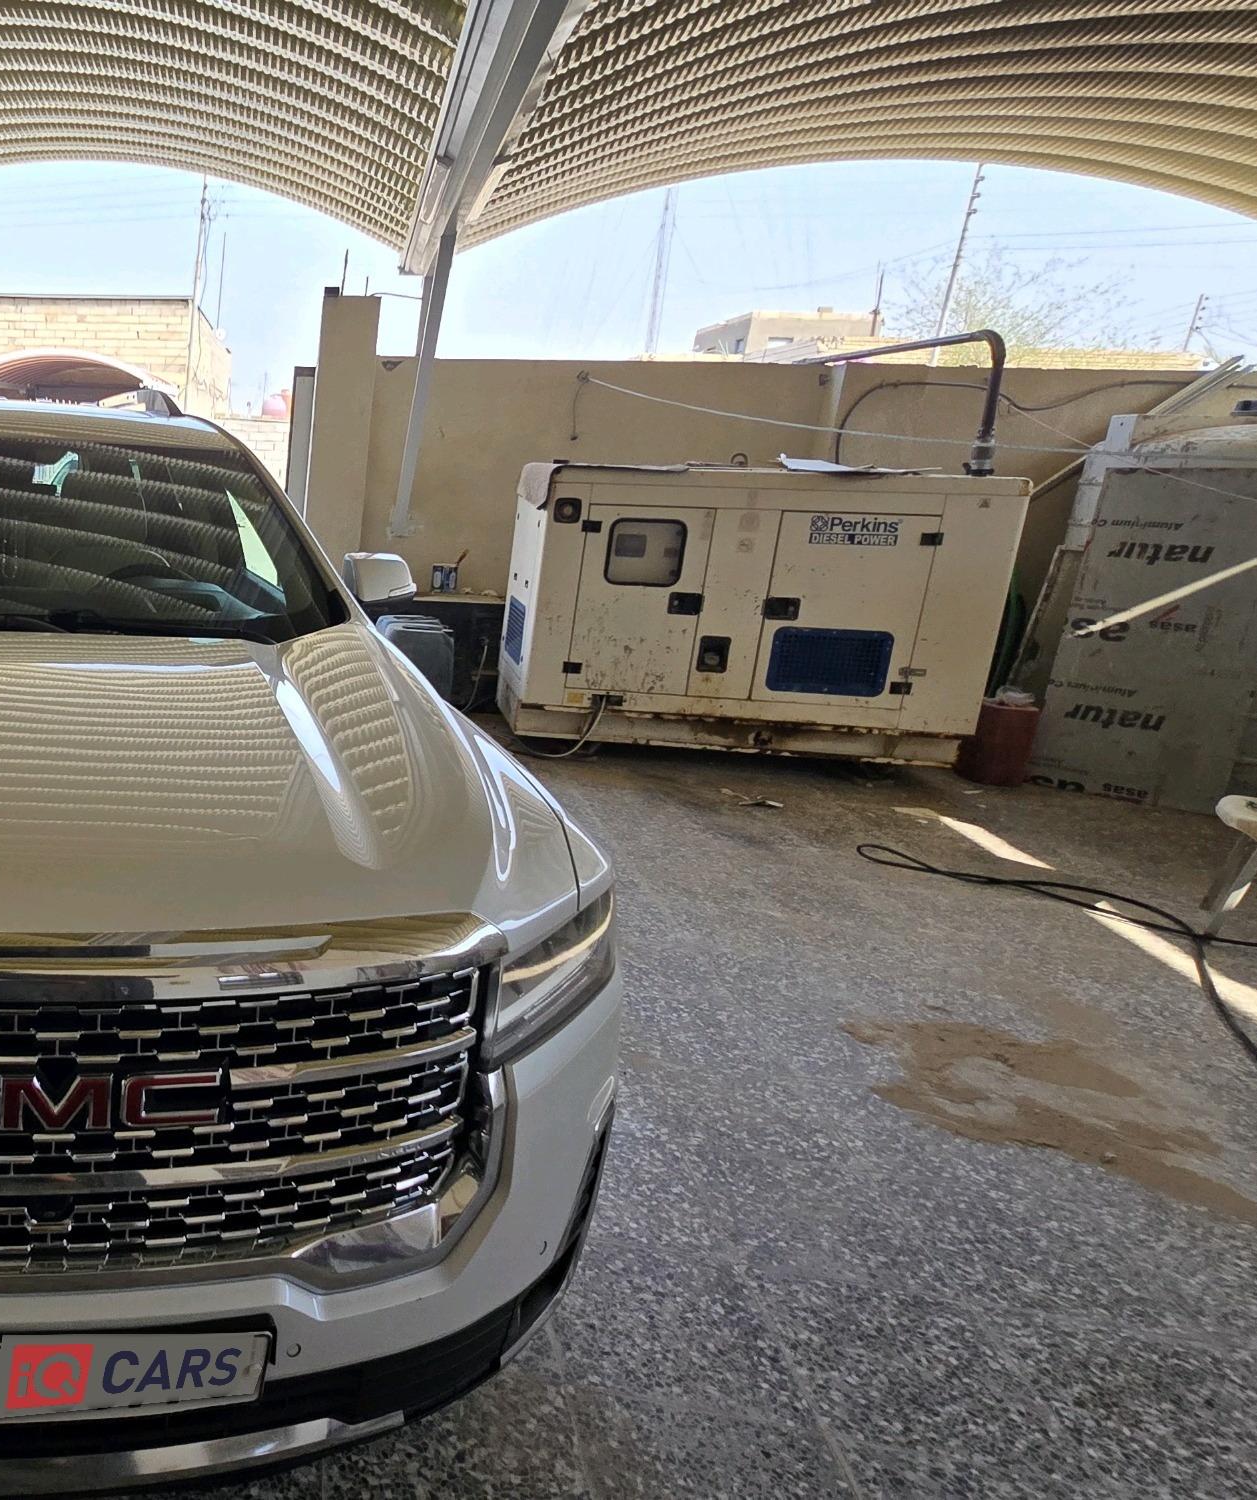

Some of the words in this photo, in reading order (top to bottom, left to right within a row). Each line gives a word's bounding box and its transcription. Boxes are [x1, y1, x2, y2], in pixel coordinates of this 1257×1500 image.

[829, 517, 899, 533] Perkins
[811, 533, 852, 544] DIESEL
[854, 534, 896, 546] POWER
[1107, 541, 1215, 565] natur
[1065, 703, 1166, 732] natur
